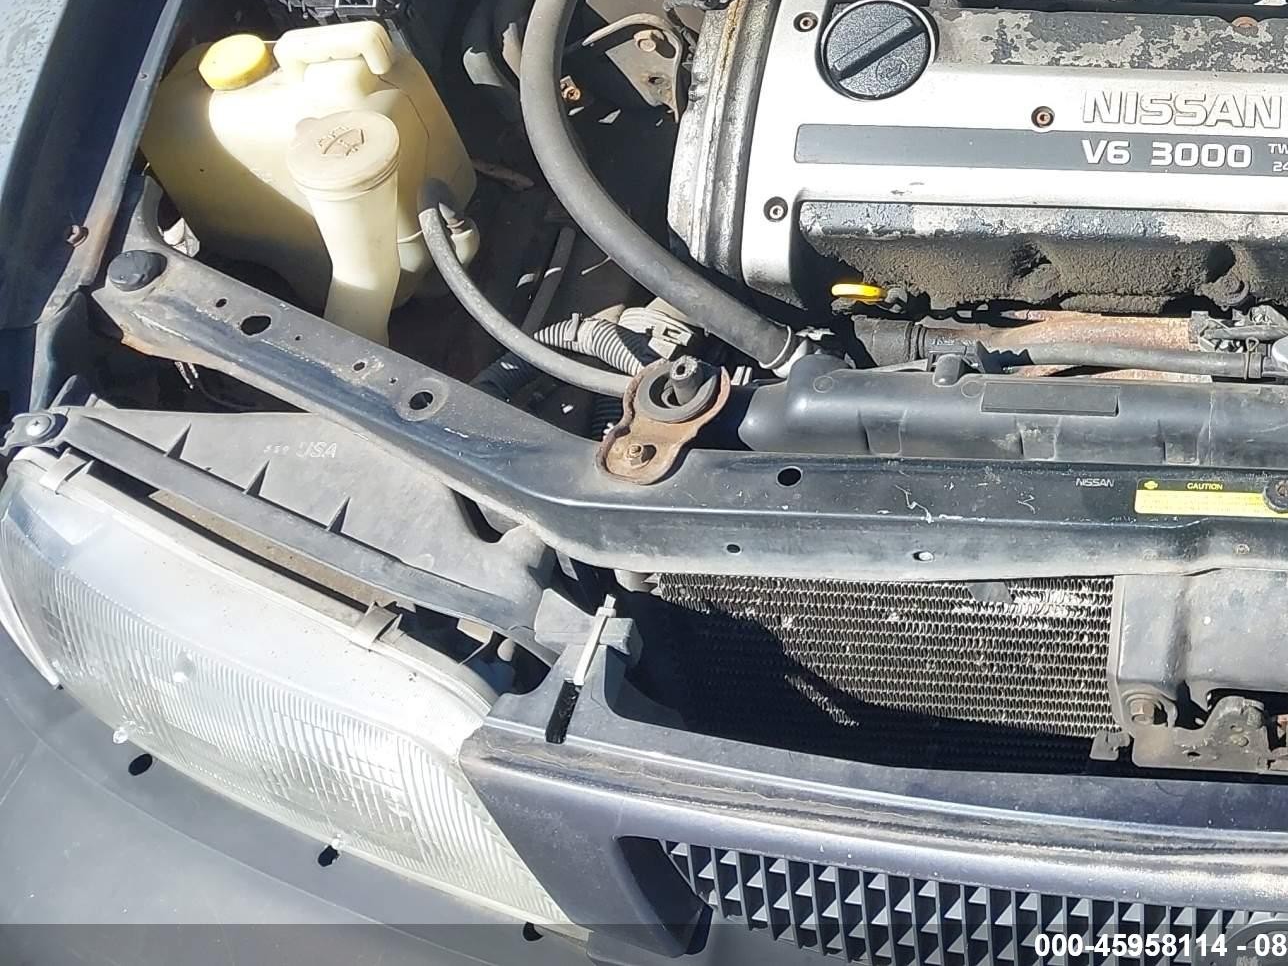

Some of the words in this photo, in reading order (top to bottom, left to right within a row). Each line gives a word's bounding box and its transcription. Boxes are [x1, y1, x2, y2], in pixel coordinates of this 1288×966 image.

[1083, 90, 1282, 129] NISSAN
[1081, 139, 1131, 165] V6
[1151, 141, 1252, 168] 3000
[1075, 477, 1115, 487] NISSAN
[1187, 482, 1223, 490] CAUTION
